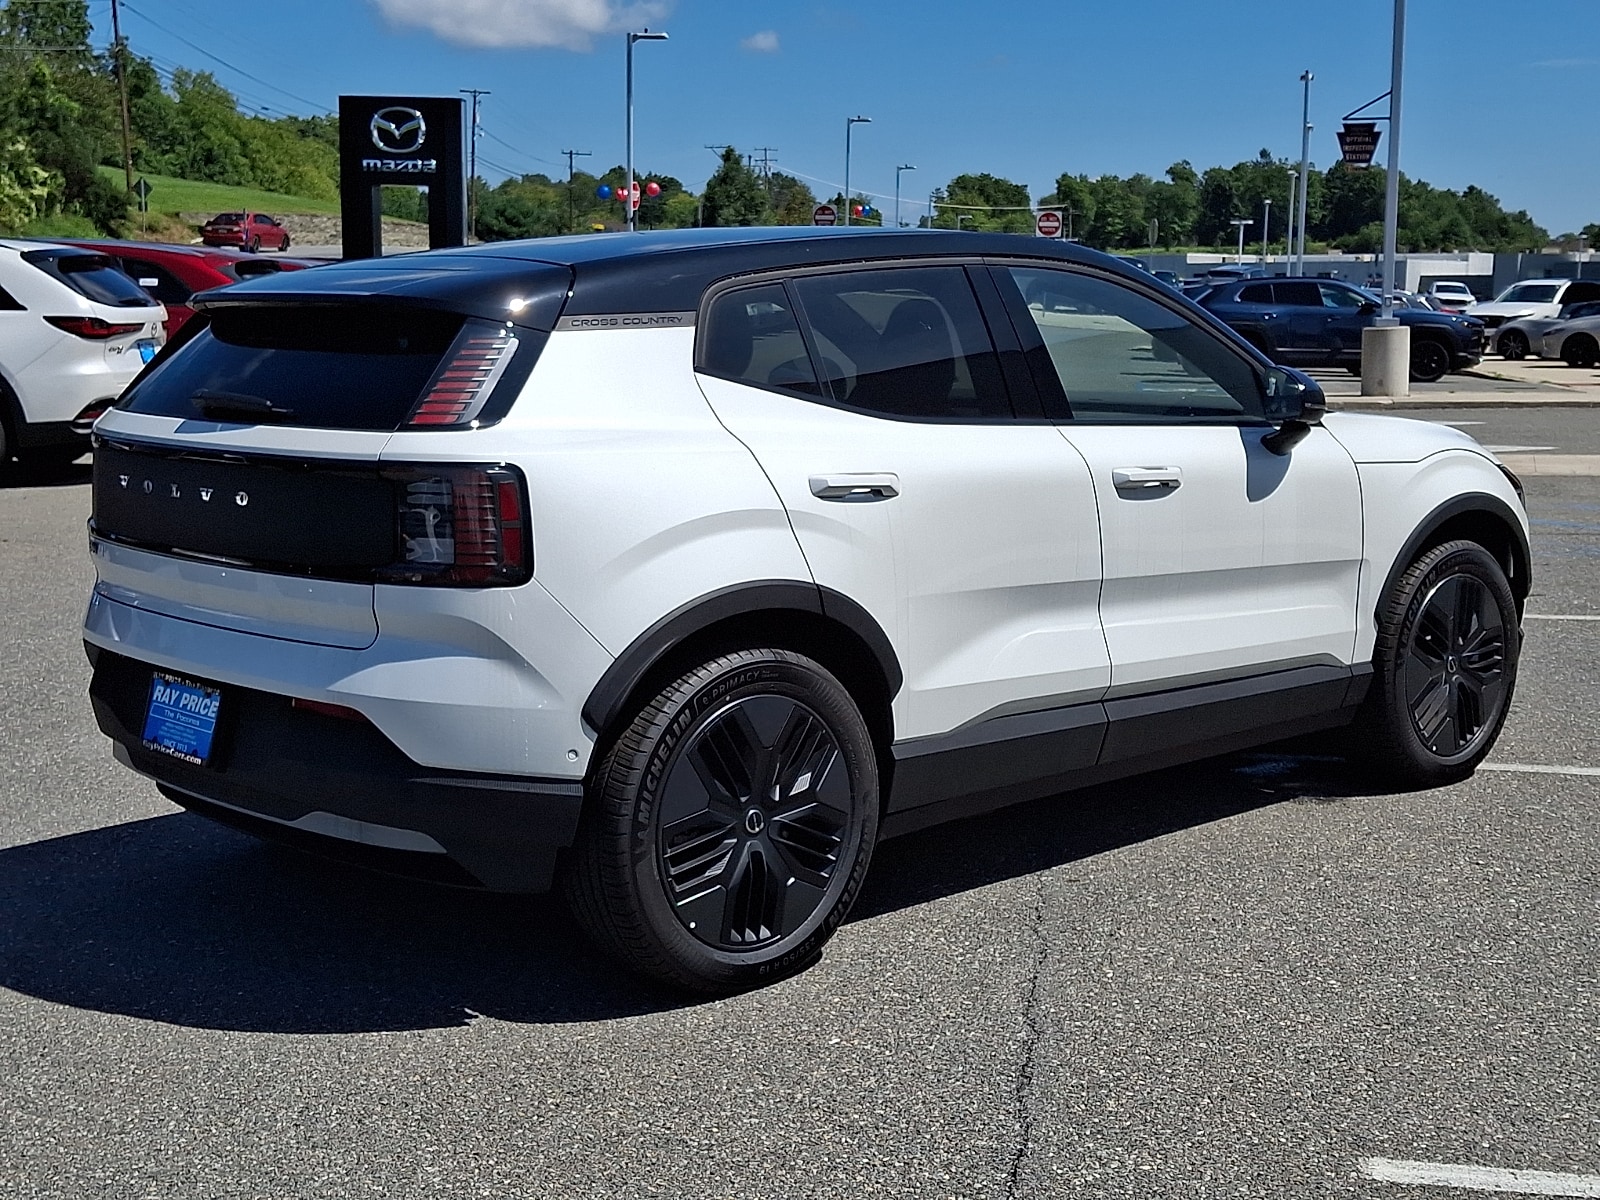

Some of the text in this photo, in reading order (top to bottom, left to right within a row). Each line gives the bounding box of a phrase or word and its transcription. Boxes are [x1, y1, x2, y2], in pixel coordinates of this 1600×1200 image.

[362, 159, 437, 173] mazda
[571, 316, 683, 327] CROSS COUNTRY
[119, 474, 249, 506] VOLVO
[153, 685, 180, 705] RAY
[180, 692, 219, 717] PRICE
[164, 709, 174, 719] The
[638, 708, 692, 824] MICHELIN
[759, 965, 770, 974] 19
